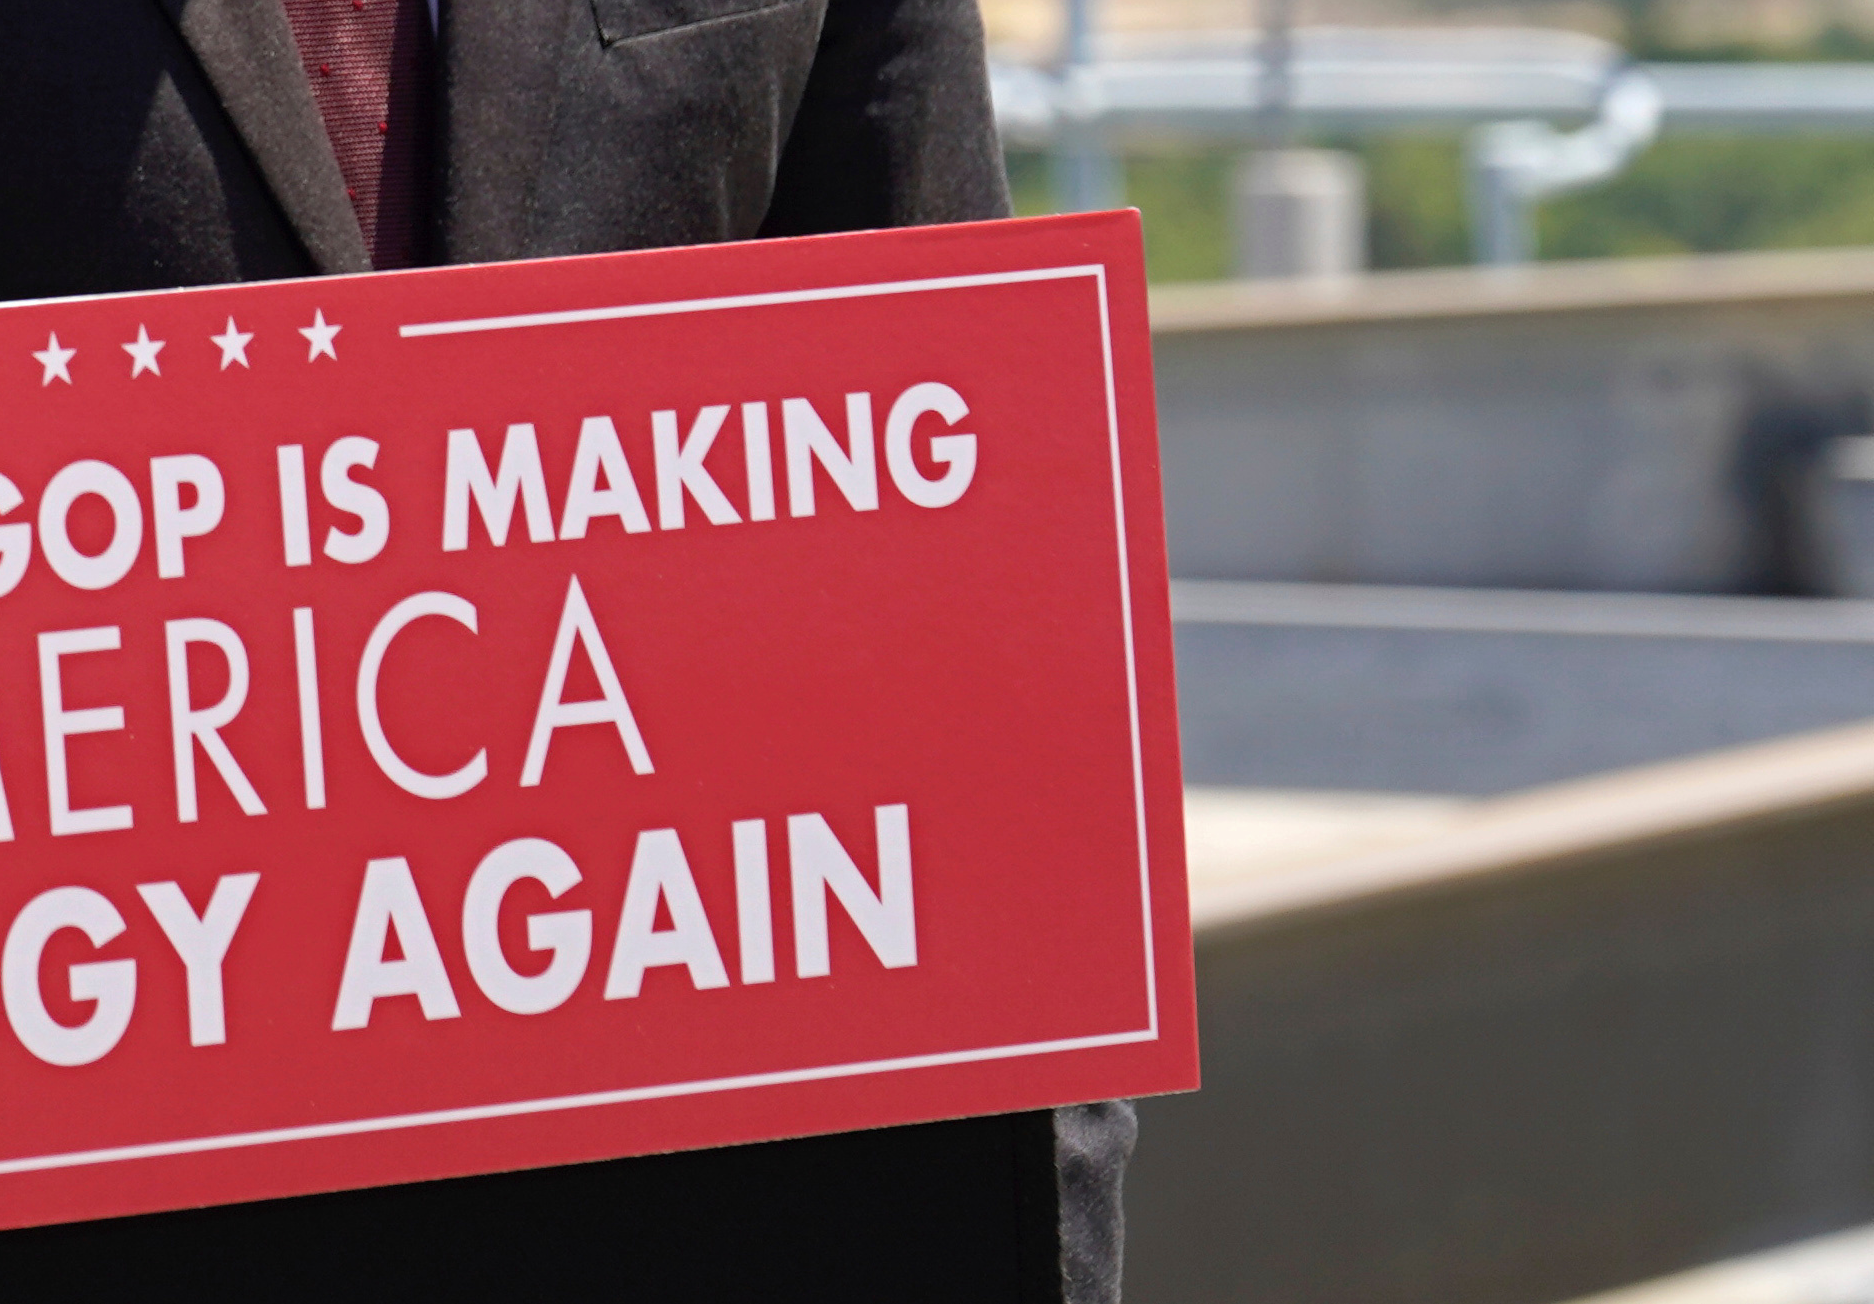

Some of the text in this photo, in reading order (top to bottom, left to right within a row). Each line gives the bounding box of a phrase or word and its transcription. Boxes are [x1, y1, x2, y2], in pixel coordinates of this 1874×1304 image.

[277, 436, 391, 568] IS
[442, 381, 978, 552] MAKING
[332, 803, 919, 1032] AGAIN
